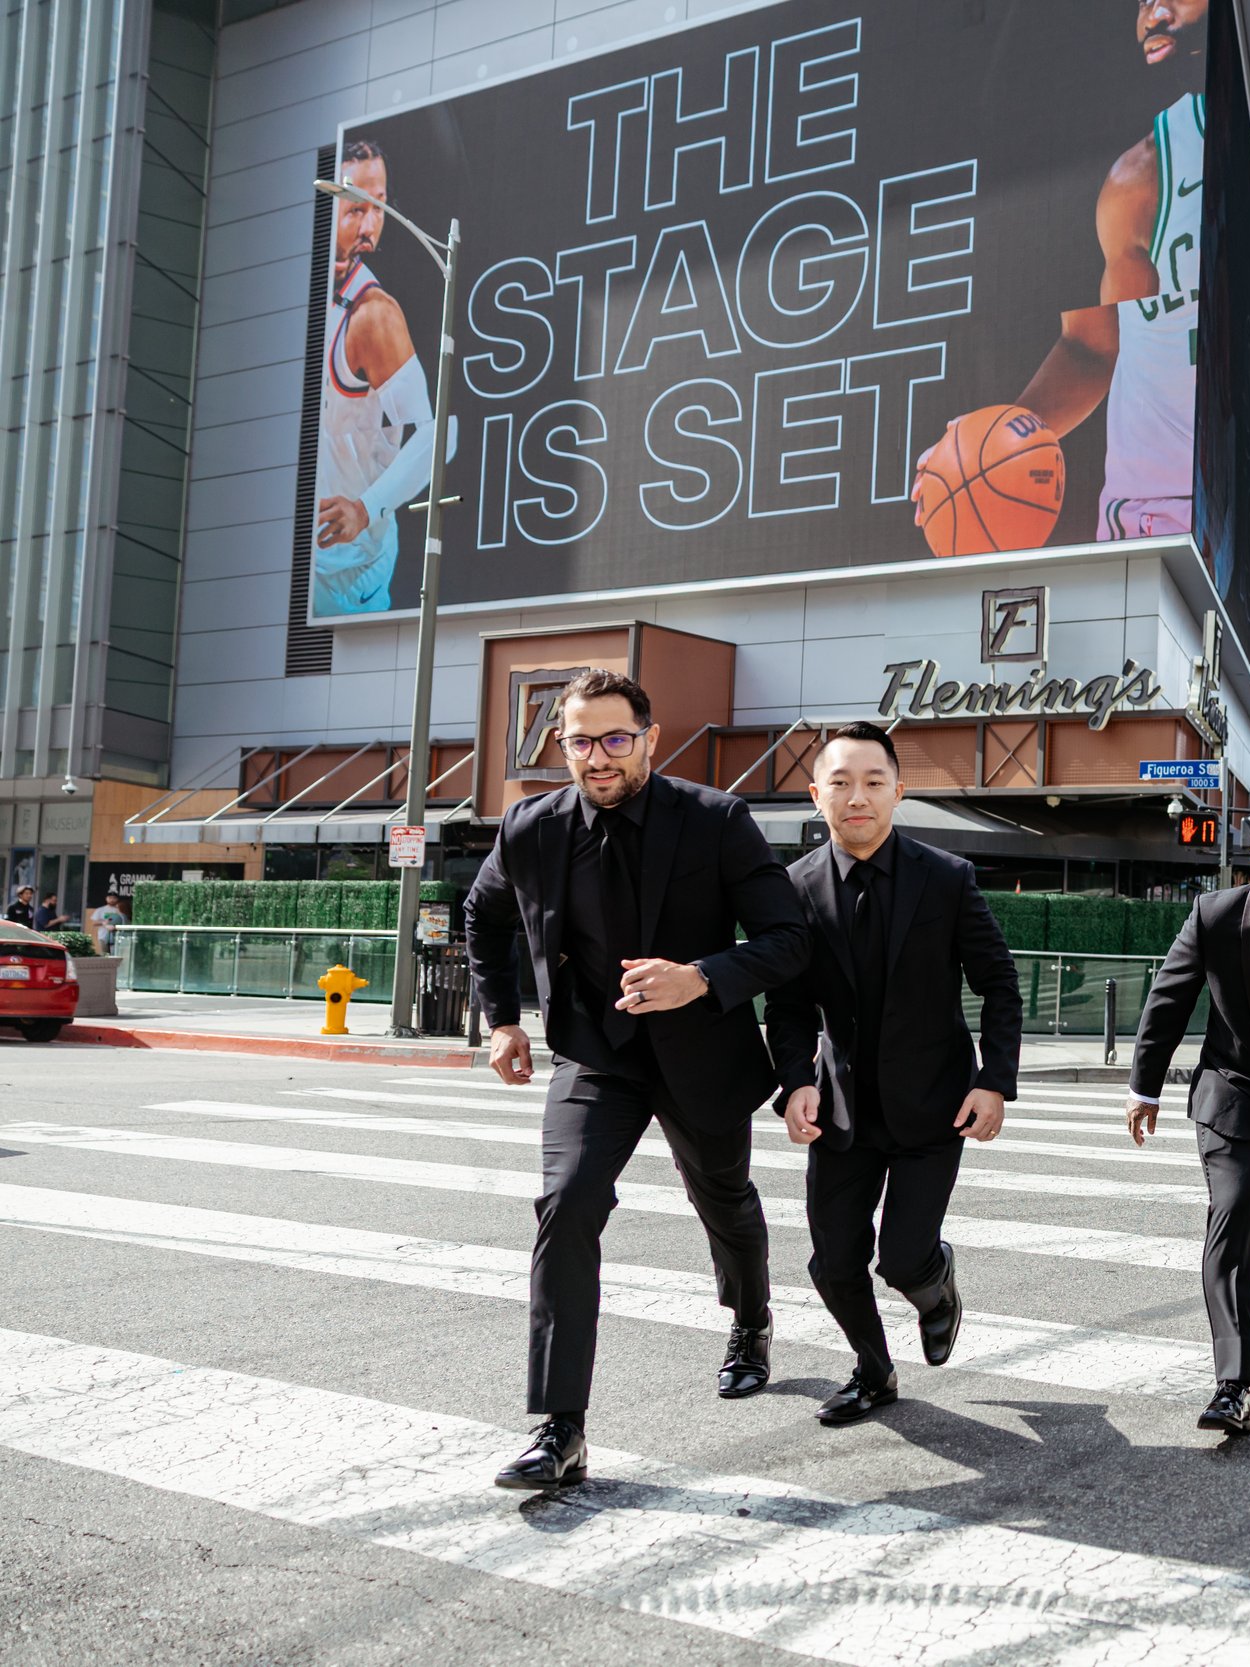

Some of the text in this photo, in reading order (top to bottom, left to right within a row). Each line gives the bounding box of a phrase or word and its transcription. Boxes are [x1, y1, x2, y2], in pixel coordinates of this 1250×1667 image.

[567, 17, 862, 225] THE
[462, 158, 978, 400] STAGE
[477, 341, 947, 550] IS SET
[878, 658, 1164, 732] Fleming's
[1147, 764, 1194, 778] Figueroa
[1190, 779, 1208, 787] 1000
[1202, 820, 1215, 843] 17
